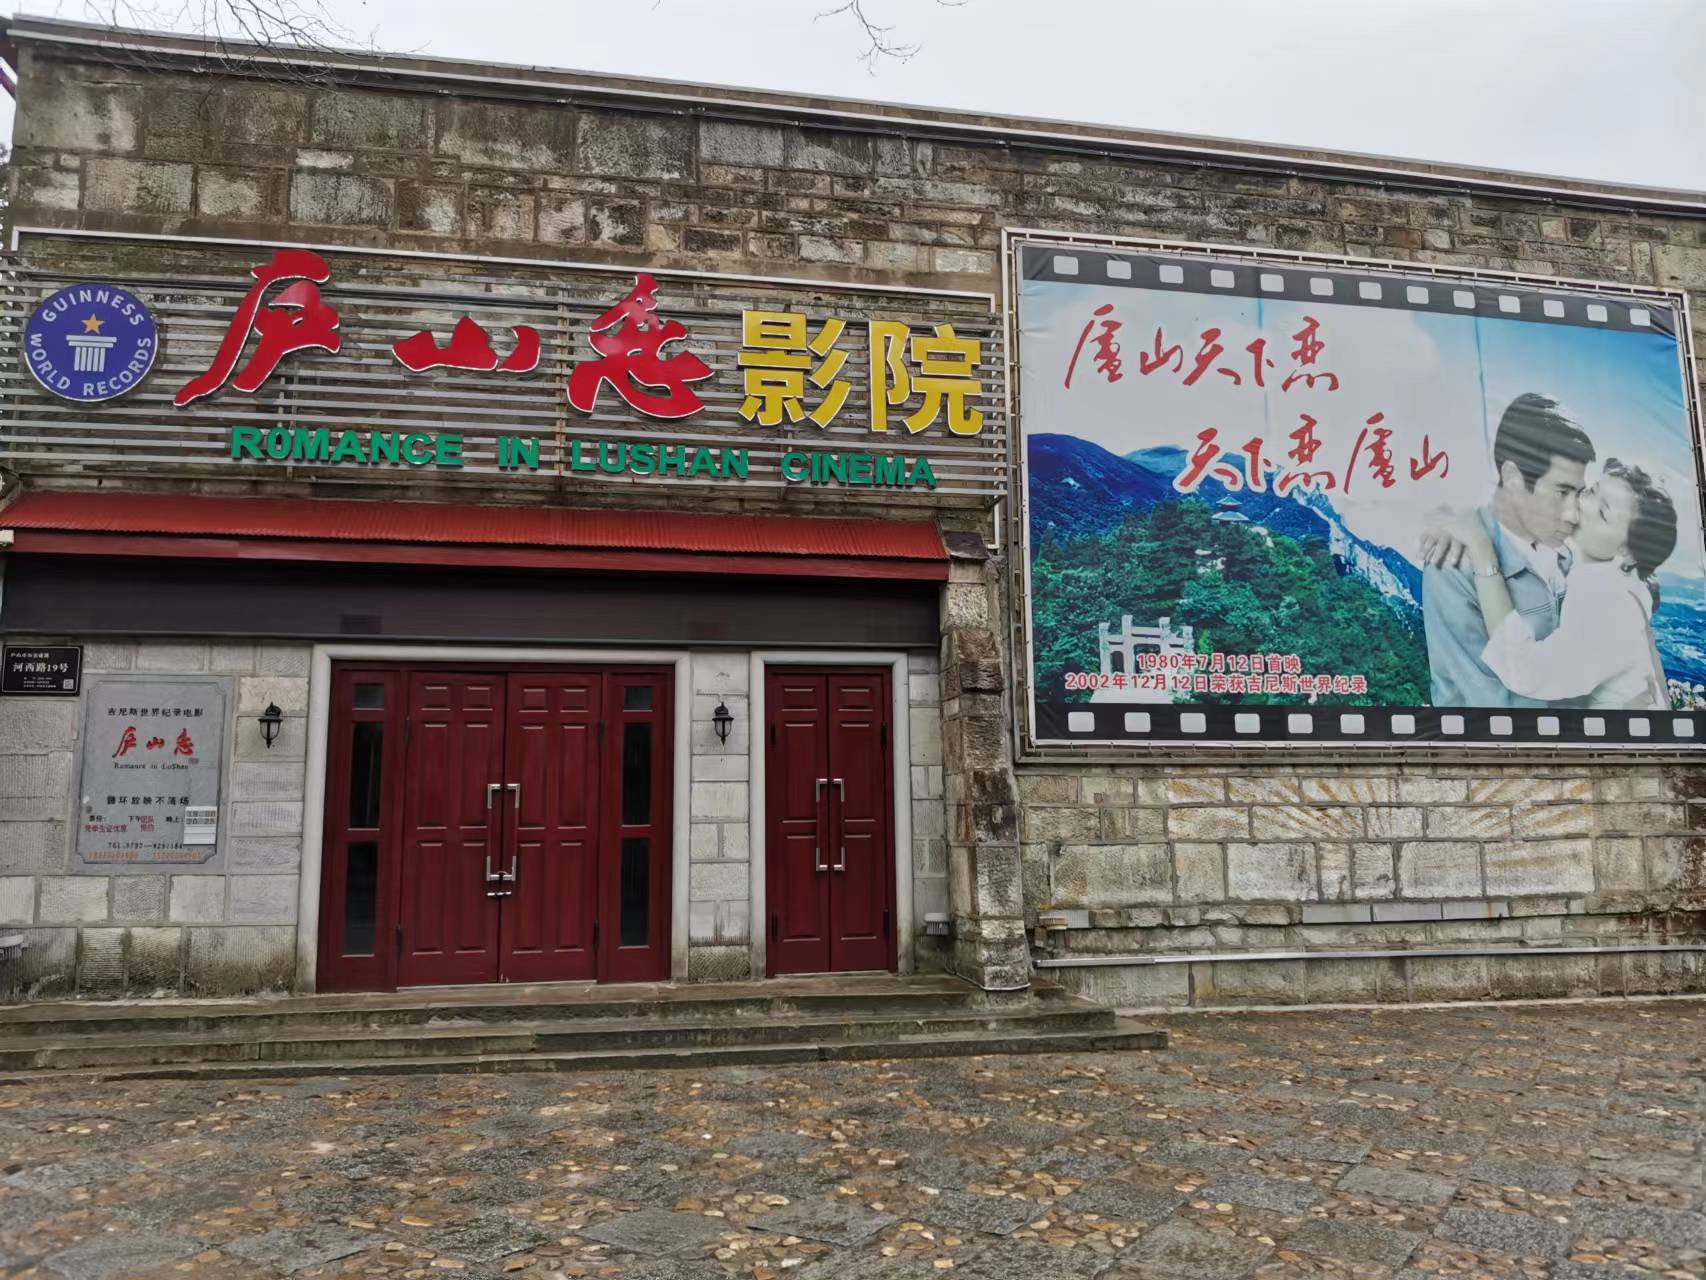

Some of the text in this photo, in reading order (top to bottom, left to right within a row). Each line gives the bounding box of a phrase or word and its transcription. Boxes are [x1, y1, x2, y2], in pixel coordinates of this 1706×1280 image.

[42, 290, 145, 326] GUINNESS
[31, 334, 152, 397] WORLD RECORDS
[231, 425, 937, 488] ROMANCE IN LUSHAN CINEMA
[13, 662, 69, 673] 河西路19号
[1136, 654, 1301, 673] 1980年7月12日首映
[1065, 673, 1367, 694] 2002年12月12日荣获吉尼斯世界纪录
[108, 707, 203, 717] 吉尼斯世界纪录电影
